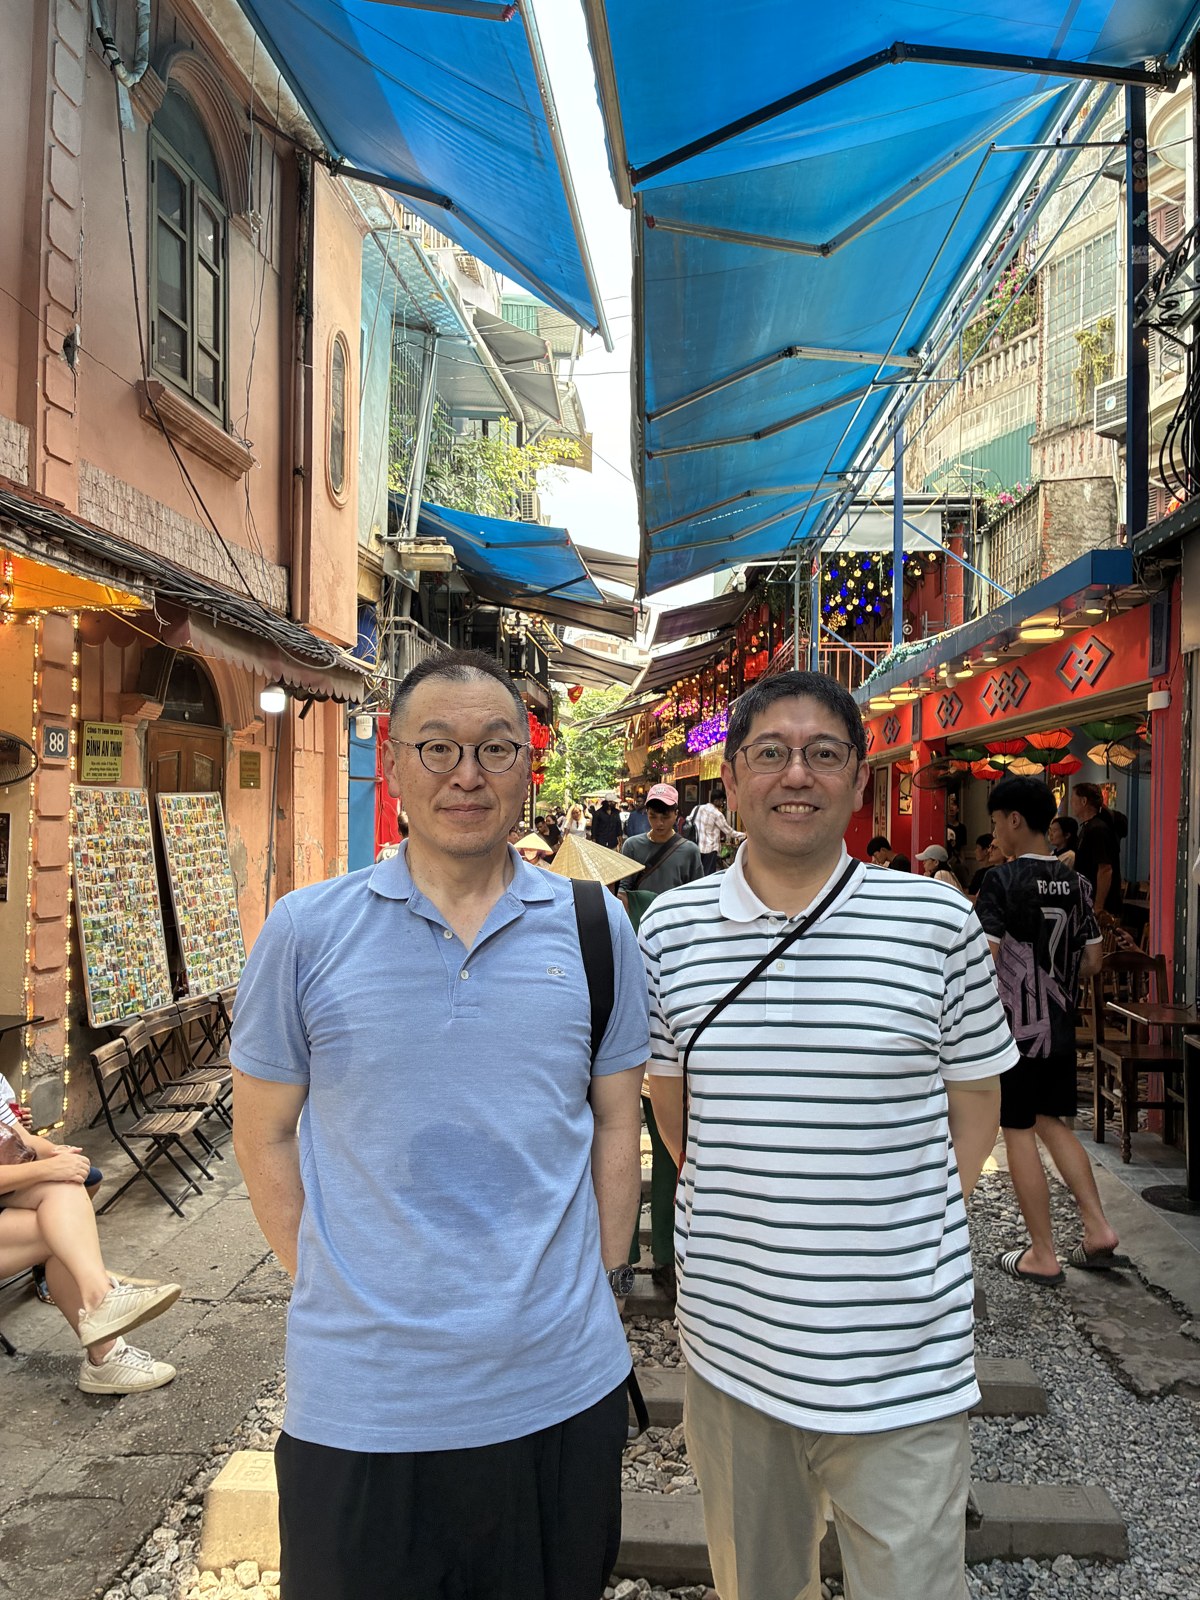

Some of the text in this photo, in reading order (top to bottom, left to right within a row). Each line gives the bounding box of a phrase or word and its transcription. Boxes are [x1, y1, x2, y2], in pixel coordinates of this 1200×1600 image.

[49, 732, 64, 752] 88
[101, 741, 109, 757] AN
[1037, 880, 1071, 895] FC CTC
[1040, 907, 1068, 977] 7
